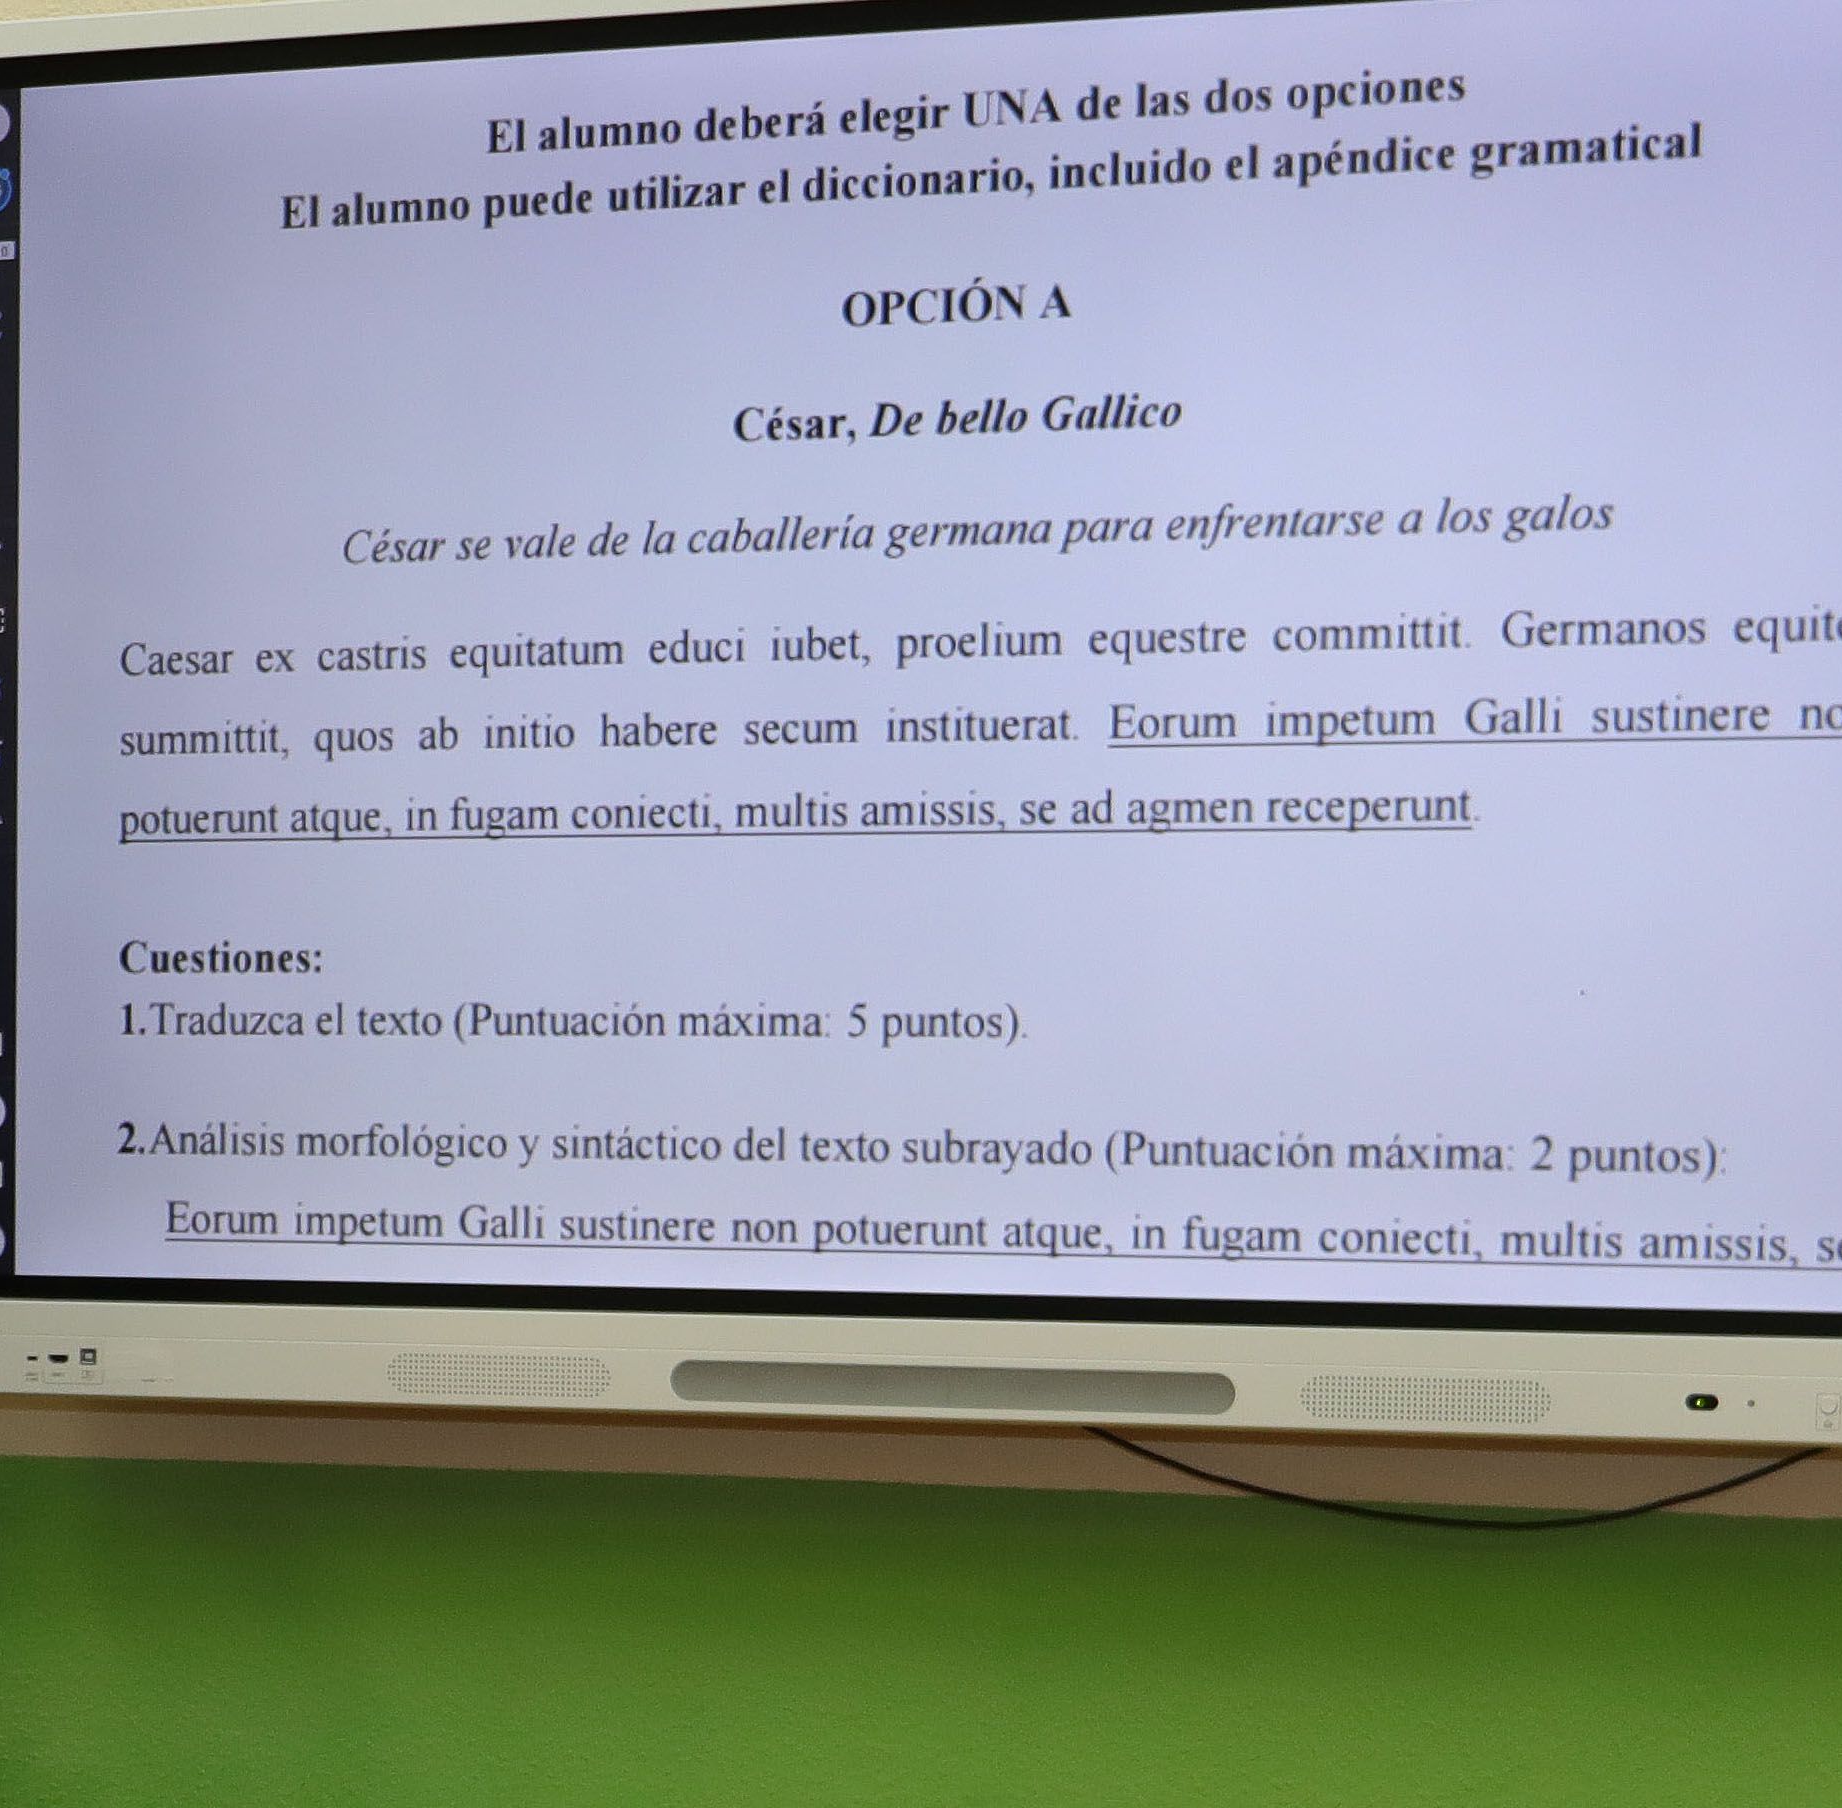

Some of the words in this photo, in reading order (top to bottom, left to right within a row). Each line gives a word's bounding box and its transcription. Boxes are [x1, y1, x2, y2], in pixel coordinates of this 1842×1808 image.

[486, 116, 526, 155] El
[536, 114, 683, 153] alumno
[692, 99, 827, 144] deberá
[838, 92, 952, 143] elegir
[962, 86, 1063, 129] UNA
[1074, 83, 1123, 123] de
[1134, 80, 1192, 119] las
[1202, 76, 1274, 116] dos
[1285, 68, 1467, 121] opciones
[279, 193, 320, 231] El
[330, 190, 472, 229] alumno
[482, 178, 594, 231] puede
[606, 172, 748, 214] utilizar
[756, 166, 791, 206] el
[801, 155, 1036, 204] diccionario,
[1048, 146, 1213, 191] incluido
[1224, 142, 1260, 183] el
[1271, 133, 1456, 190] apéndice
[1468, 119, 1703, 181] gramatical
[840, 275, 1027, 329] OPCIÓN
[1038, 282, 1073, 320] A
[732, 405, 857, 446] César,
[867, 400, 925, 439] De
[934, 396, 1030, 437] bello
[1040, 391, 1184, 433] Gallico
[342, 527, 448, 566] César
[454, 535, 492, 562] se
[503, 521, 577, 561] vale
[585, 520, 631, 558] de
[641, 518, 677, 557] la
[685, 512, 876, 556] caballería
[882, 518, 1054, 561] germana
[1058, 515, 1155, 556] para
[1164, 501, 1385, 552] enfrentarse
[1396, 508, 1425, 536] a
[1435, 495, 1494, 535] los
[1501, 491, 1615, 544] galos
[119, 641, 235, 678] Caesar
[254, 648, 296, 675] ex
[316, 634, 428, 673] castris
[448, 632, 625, 680] equitatum
[647, 626, 746, 666] educi
[770, 624, 872, 668] iubet,
[895, 620, 1064, 671] proelium
[1086, 620, 1248, 667] equestre
[1271, 611, 1474, 653] committit.
[1500, 609, 1707, 650] Germanos
[119, 718, 290, 767] summittit,
[312, 726, 395, 765] quos
[417, 714, 460, 754] ab
[484, 712, 577, 753] initio
[599, 710, 719, 751] habere
[743, 718, 859, 748] secum
[885, 705, 1080, 746] instituerat.
[1108, 702, 1238, 743] Eorum
[1265, 700, 1437, 750] impetum
[1464, 695, 1563, 739] Galli
[1590, 693, 1771, 736] sustinere
[119, 803, 280, 847] potuerunt
[289, 803, 393, 845] atque,
[404, 796, 439, 836] in
[449, 795, 560, 844] fugam
[570, 792, 723, 843] coniecti,
[734, 790, 849, 832] multis
[859, 789, 1007, 840] amissis,
[1018, 798, 1058, 829] se
[1069, 786, 1115, 829] ad
[1125, 797, 1254, 837] agmen
[1266, 789, 1483, 835] receperunt.
[118, 938, 323, 976] Cuestiones:
[314, 1000, 345, 1038] el
[355, 1006, 444, 1038] texto
[452, 1000, 667, 1044] (Puntuación
[677, 1001, 831, 1039] máxima:
[846, 1001, 868, 1039] 5
[880, 1002, 1028, 1050] puntos).
[296, 1121, 509, 1169] morfológico
[517, 1133, 541, 1170] y
[551, 1124, 723, 1162] sintáctico
[732, 1125, 787, 1163] del
[798, 1131, 892, 1164] texto
[901, 1127, 1094, 1176] subrayado
[1104, 1129, 1335, 1176] (Puntuación
[1347, 1133, 1514, 1172] máxima:
[1530, 1133, 1554, 1173] 2
[1568, 1139, 1729, 1184] puntos):
[165, 1199, 280, 1240] Eorum
[294, 1200, 445, 1251] impetum
[457, 1203, 545, 1243] Galli
[558, 1205, 717, 1244] sustinere
[730, 1218, 799, 1246] non
[812, 1214, 988, 1258] potuerunt
[1002, 1217, 1114, 1261] atque,
[1131, 1213, 1167, 1254] in
[1182, 1213, 1303, 1264] fugam
[1316, 1218, 1484, 1268] coniecti,
[1500, 1219, 1624, 1262] multis
[1638, 1222, 1800, 1274] amissis,
